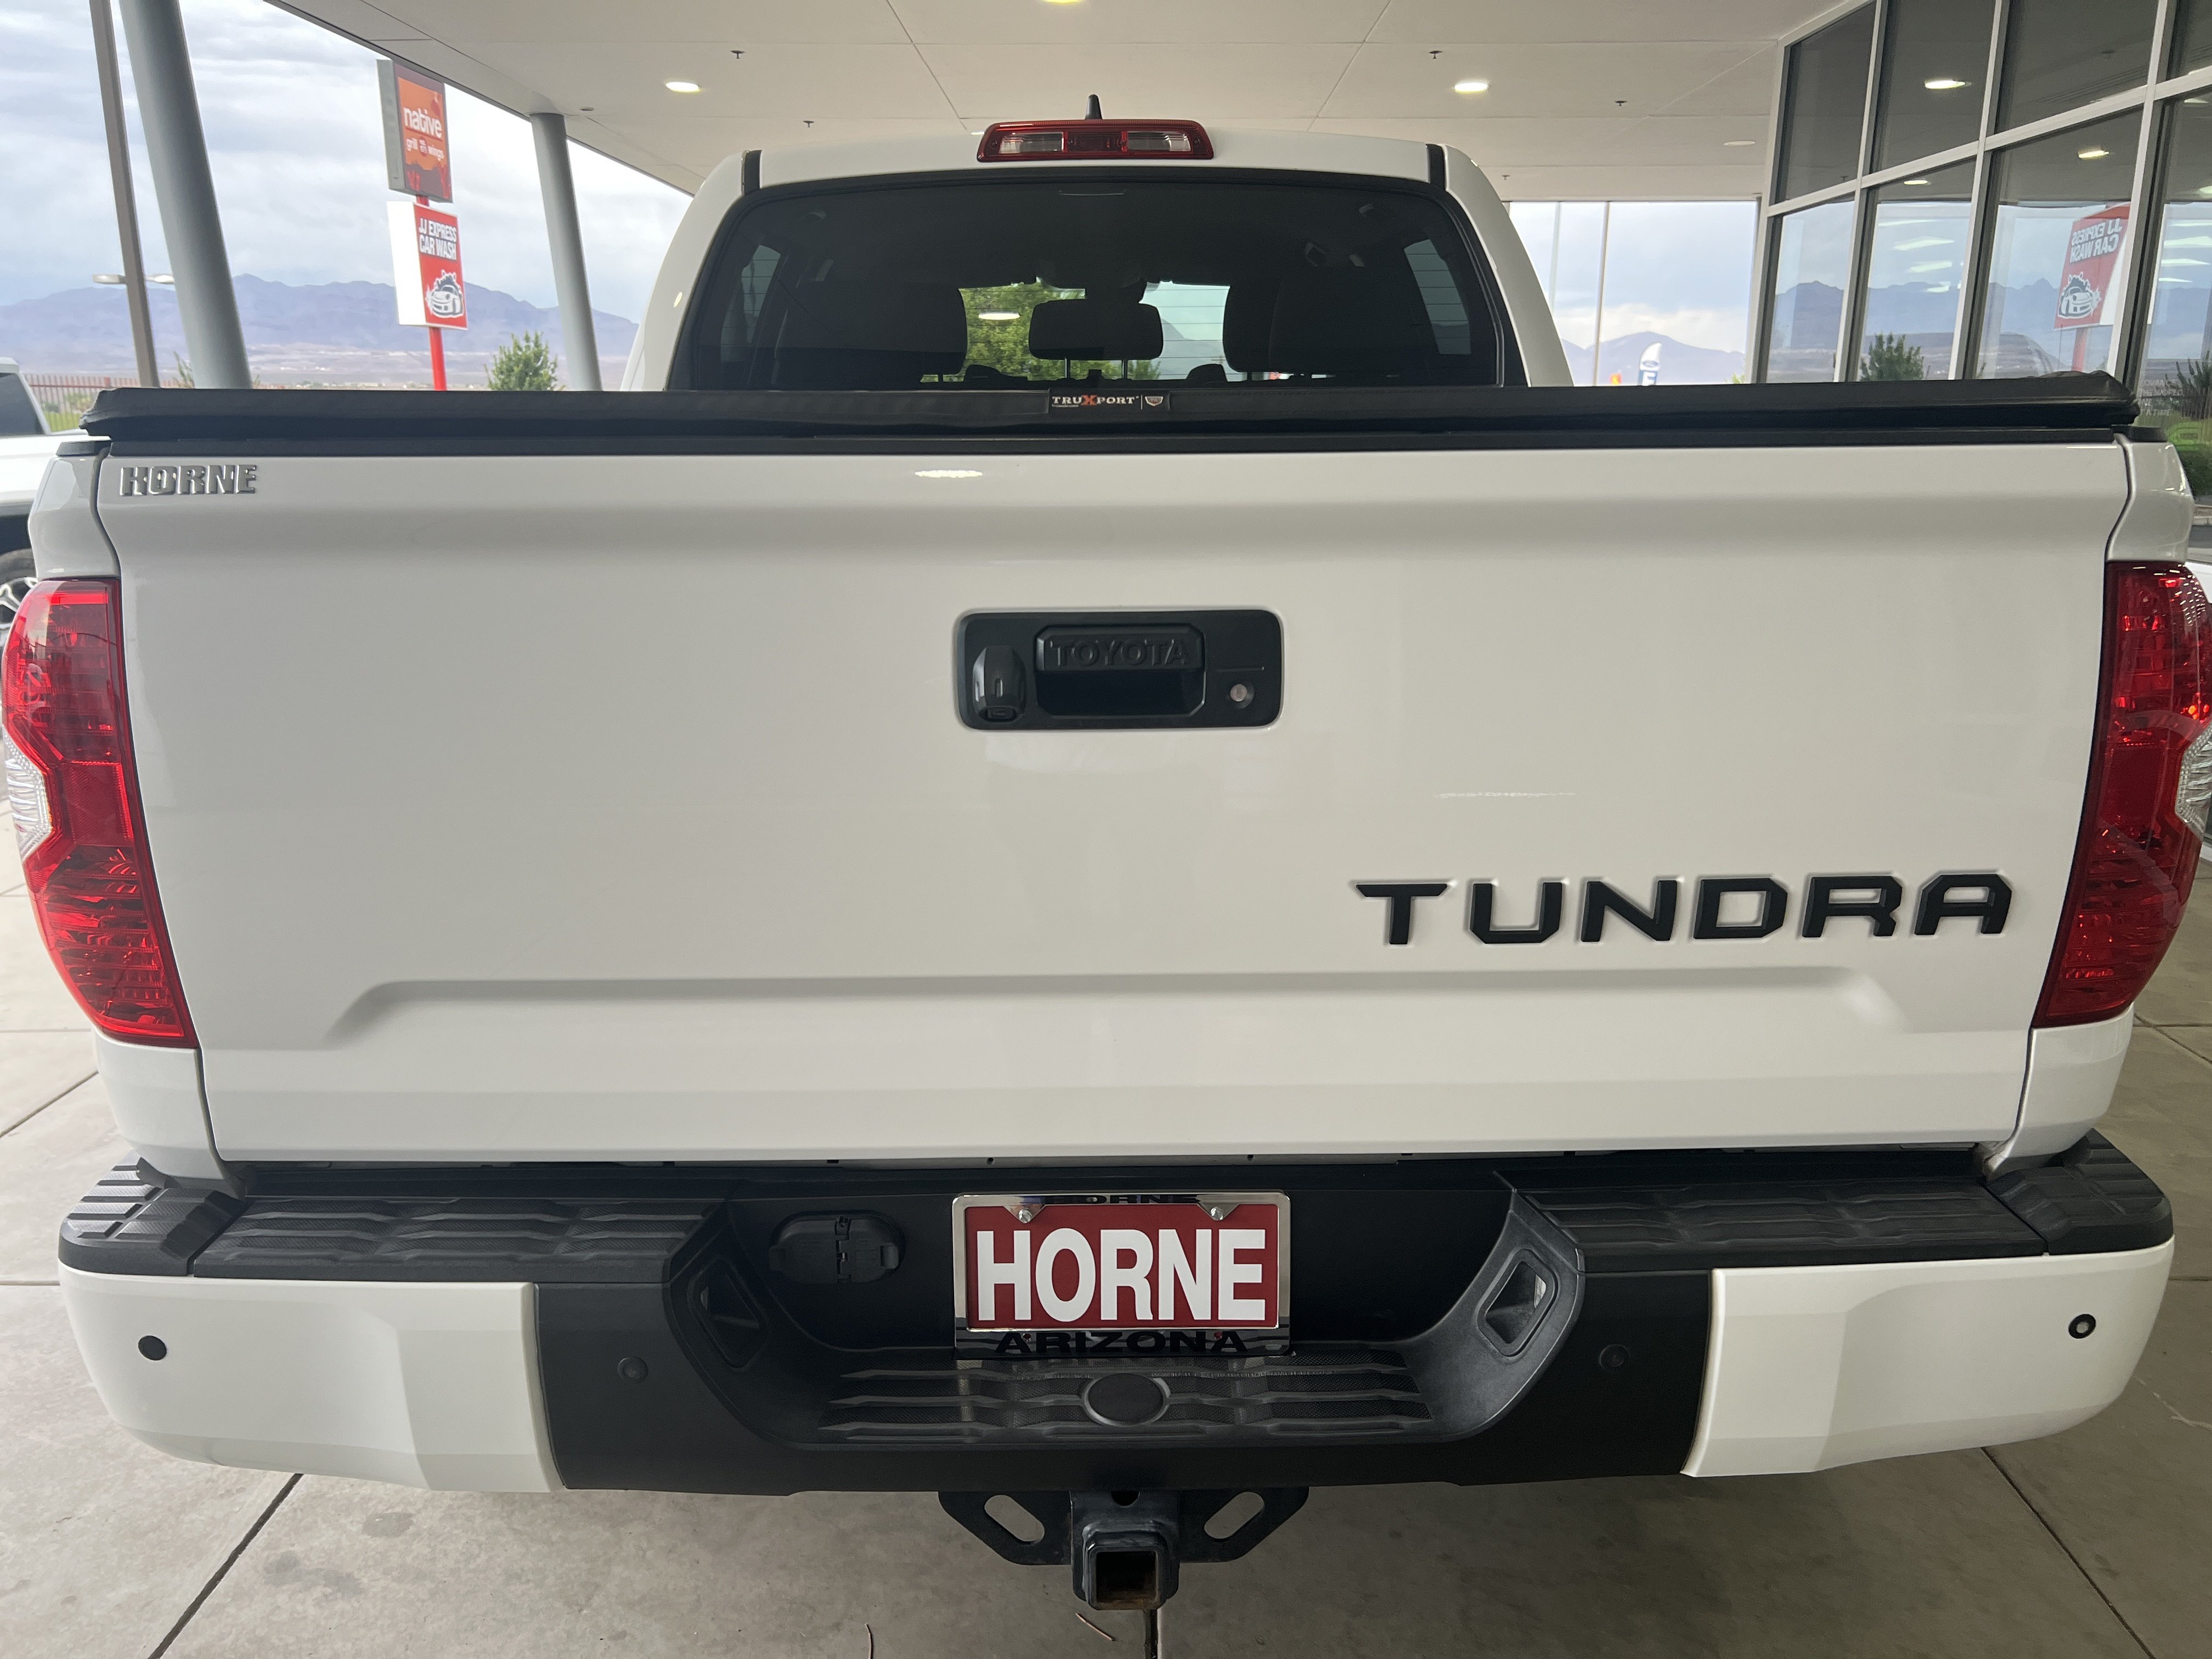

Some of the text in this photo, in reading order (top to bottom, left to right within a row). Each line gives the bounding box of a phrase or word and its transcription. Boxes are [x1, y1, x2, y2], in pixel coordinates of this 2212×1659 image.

[403, 107, 442, 138] native
[407, 138, 418, 152] grill
[428, 144, 444, 161] wings
[419, 218, 457, 242] JJ EXPRESS
[419, 234, 457, 261] CAR WASH
[1052, 394, 1136, 407] TRUXPORT
[120, 464, 257, 496] HORNE
[1049, 639, 1188, 667] TOYOTA
[1355, 873, 2013, 946] TUNDRA
[977, 1227, 1266, 1322] HORNE
[994, 1330, 1249, 1353] ARIZONA
